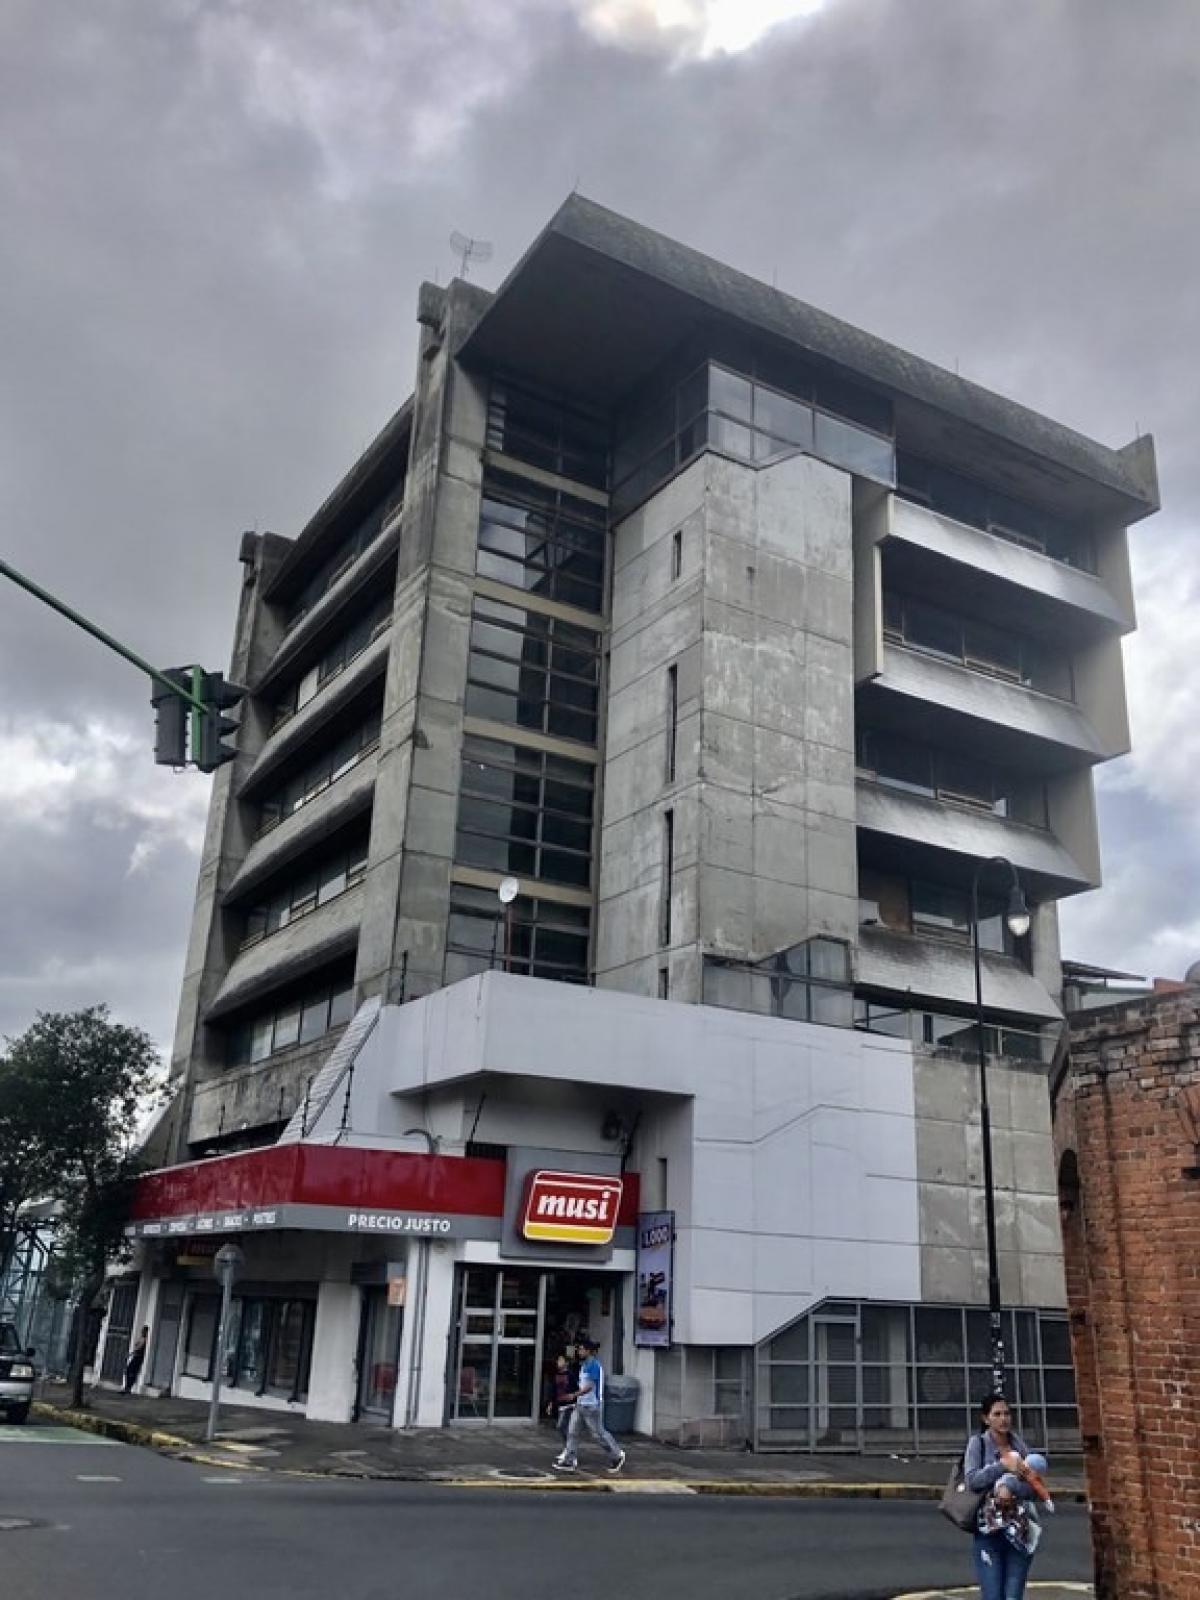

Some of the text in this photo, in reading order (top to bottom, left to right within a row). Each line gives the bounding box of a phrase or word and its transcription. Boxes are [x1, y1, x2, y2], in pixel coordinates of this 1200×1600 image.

[537, 1191, 610, 1220] musi
[348, 1214, 450, 1232] PRECIO JUSTO
